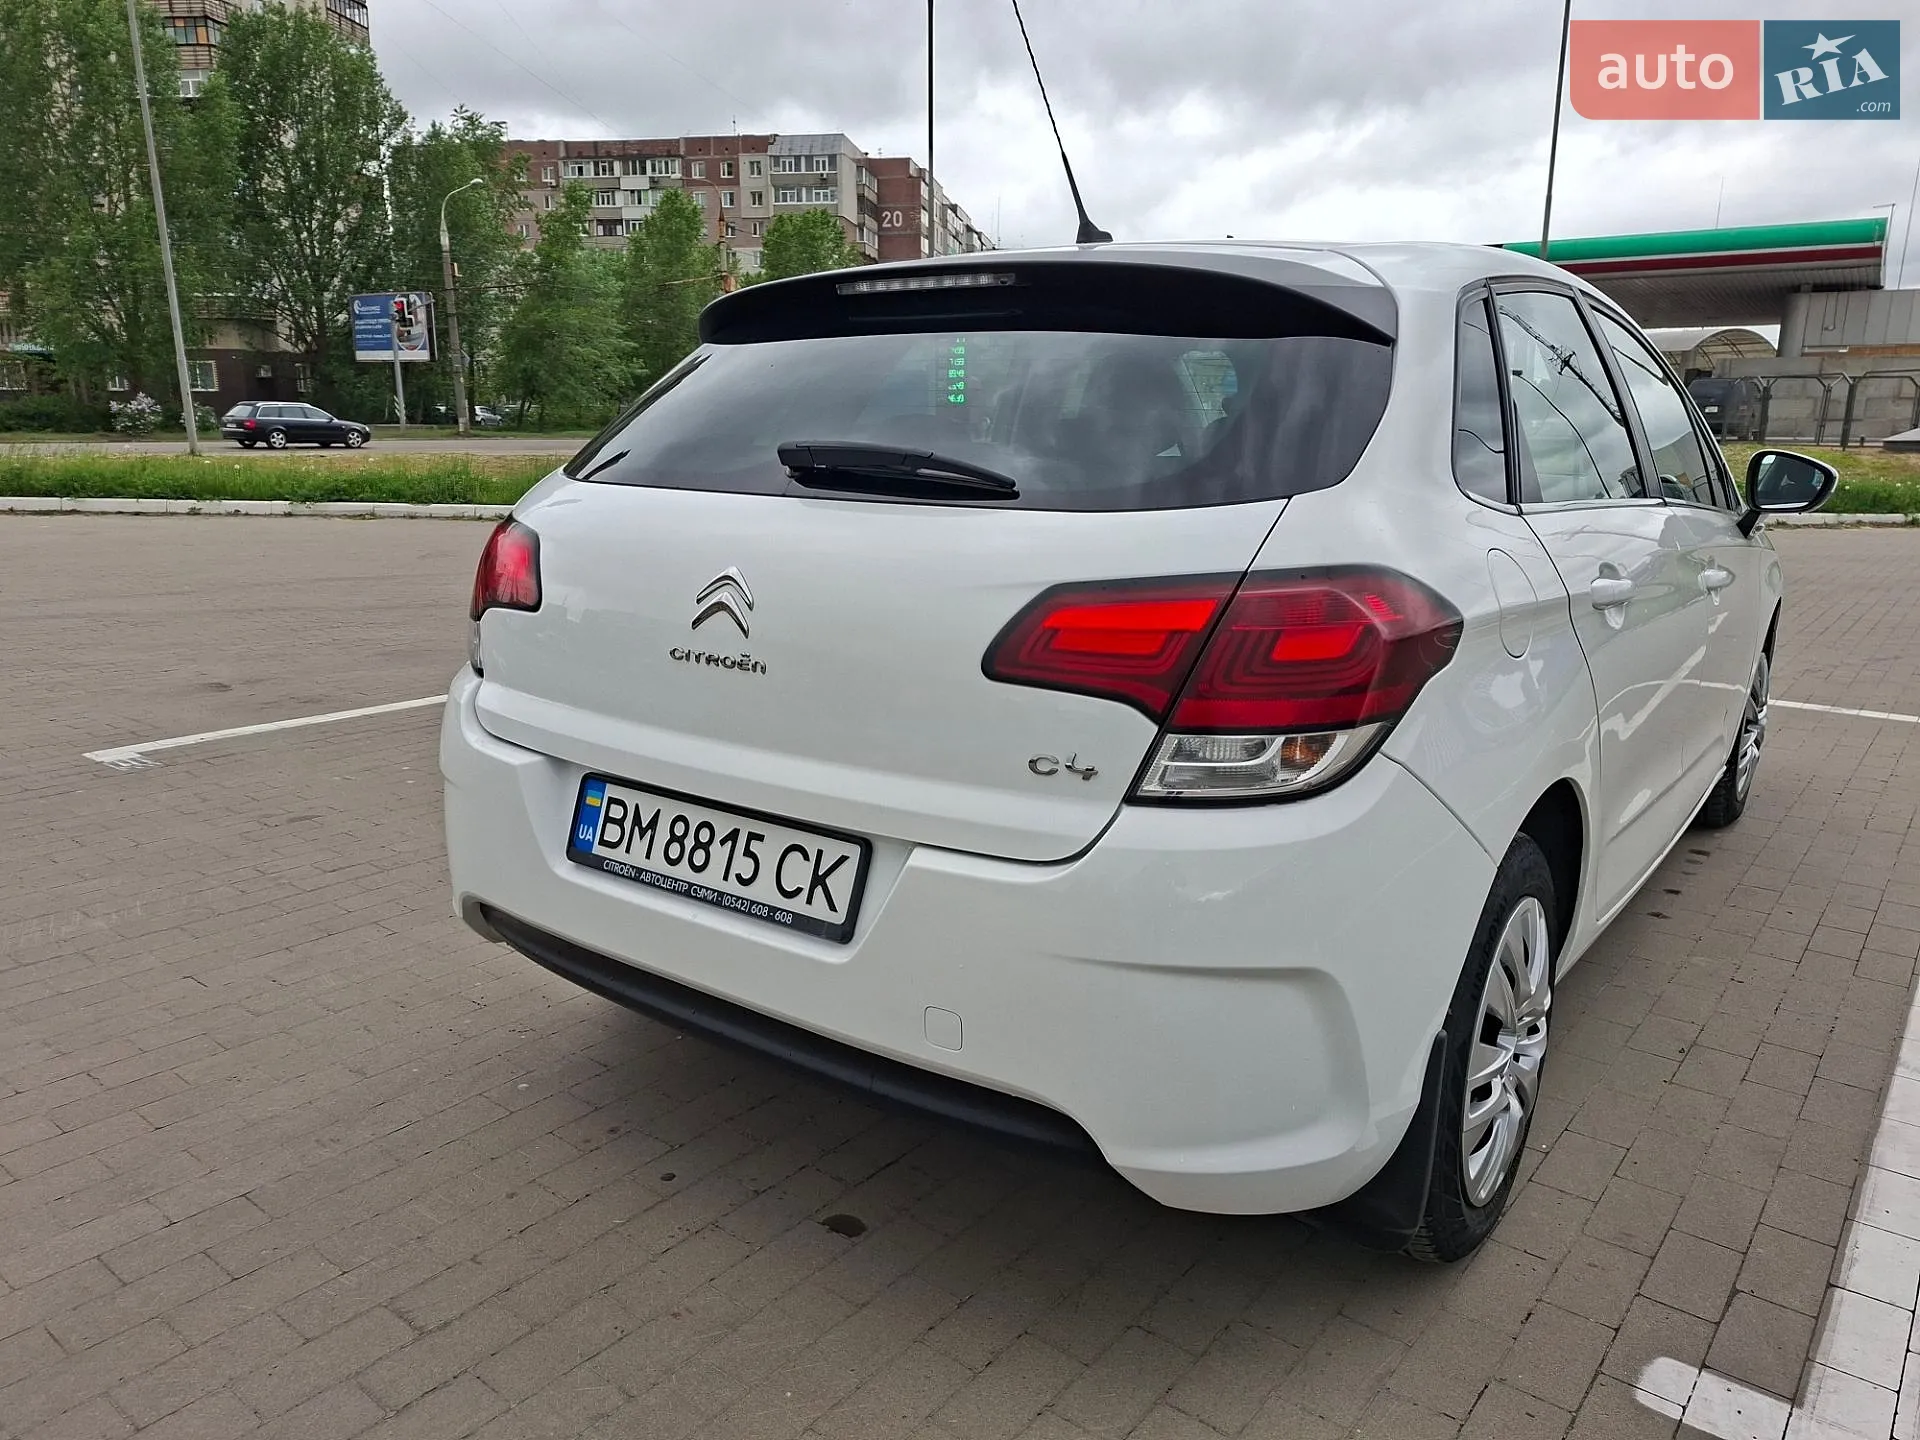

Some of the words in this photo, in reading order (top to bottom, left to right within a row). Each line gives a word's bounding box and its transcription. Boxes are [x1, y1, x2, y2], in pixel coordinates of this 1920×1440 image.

[882, 210, 903, 228] 20
[669, 647, 767, 675] CITROËN
[1028, 752, 1099, 781] C4
[578, 823, 594, 842] UA
[597, 796, 661, 860] BM
[663, 814, 766, 887] 8815
[775, 843, 850, 913] CK
[603, 859, 636, 878] CITROËN
[640, 871, 689, 893] АВТОЦЕНТР
[690, 885, 718, 903] СУМИ
[722, 894, 751, 913] (0542)
[751, 903, 769, 917] 608
[774, 911, 793, 925] 608
